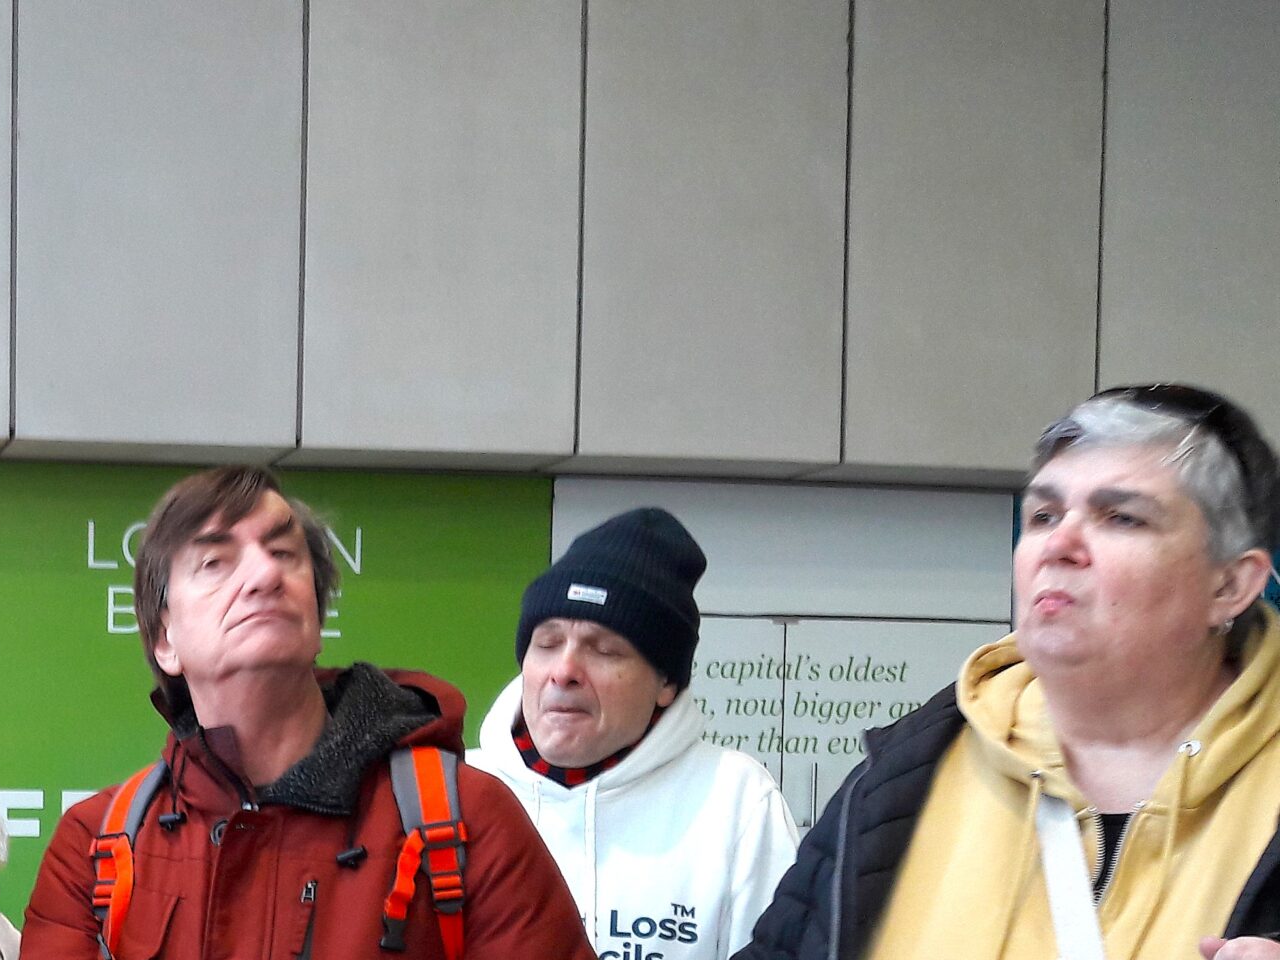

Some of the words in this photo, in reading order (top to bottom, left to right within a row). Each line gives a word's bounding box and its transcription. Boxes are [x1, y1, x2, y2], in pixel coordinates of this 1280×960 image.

[829, 656, 908, 683] oldest
[725, 697, 784, 717] now
[793, 691, 881, 725] bigger
[756, 726, 819, 754] than
